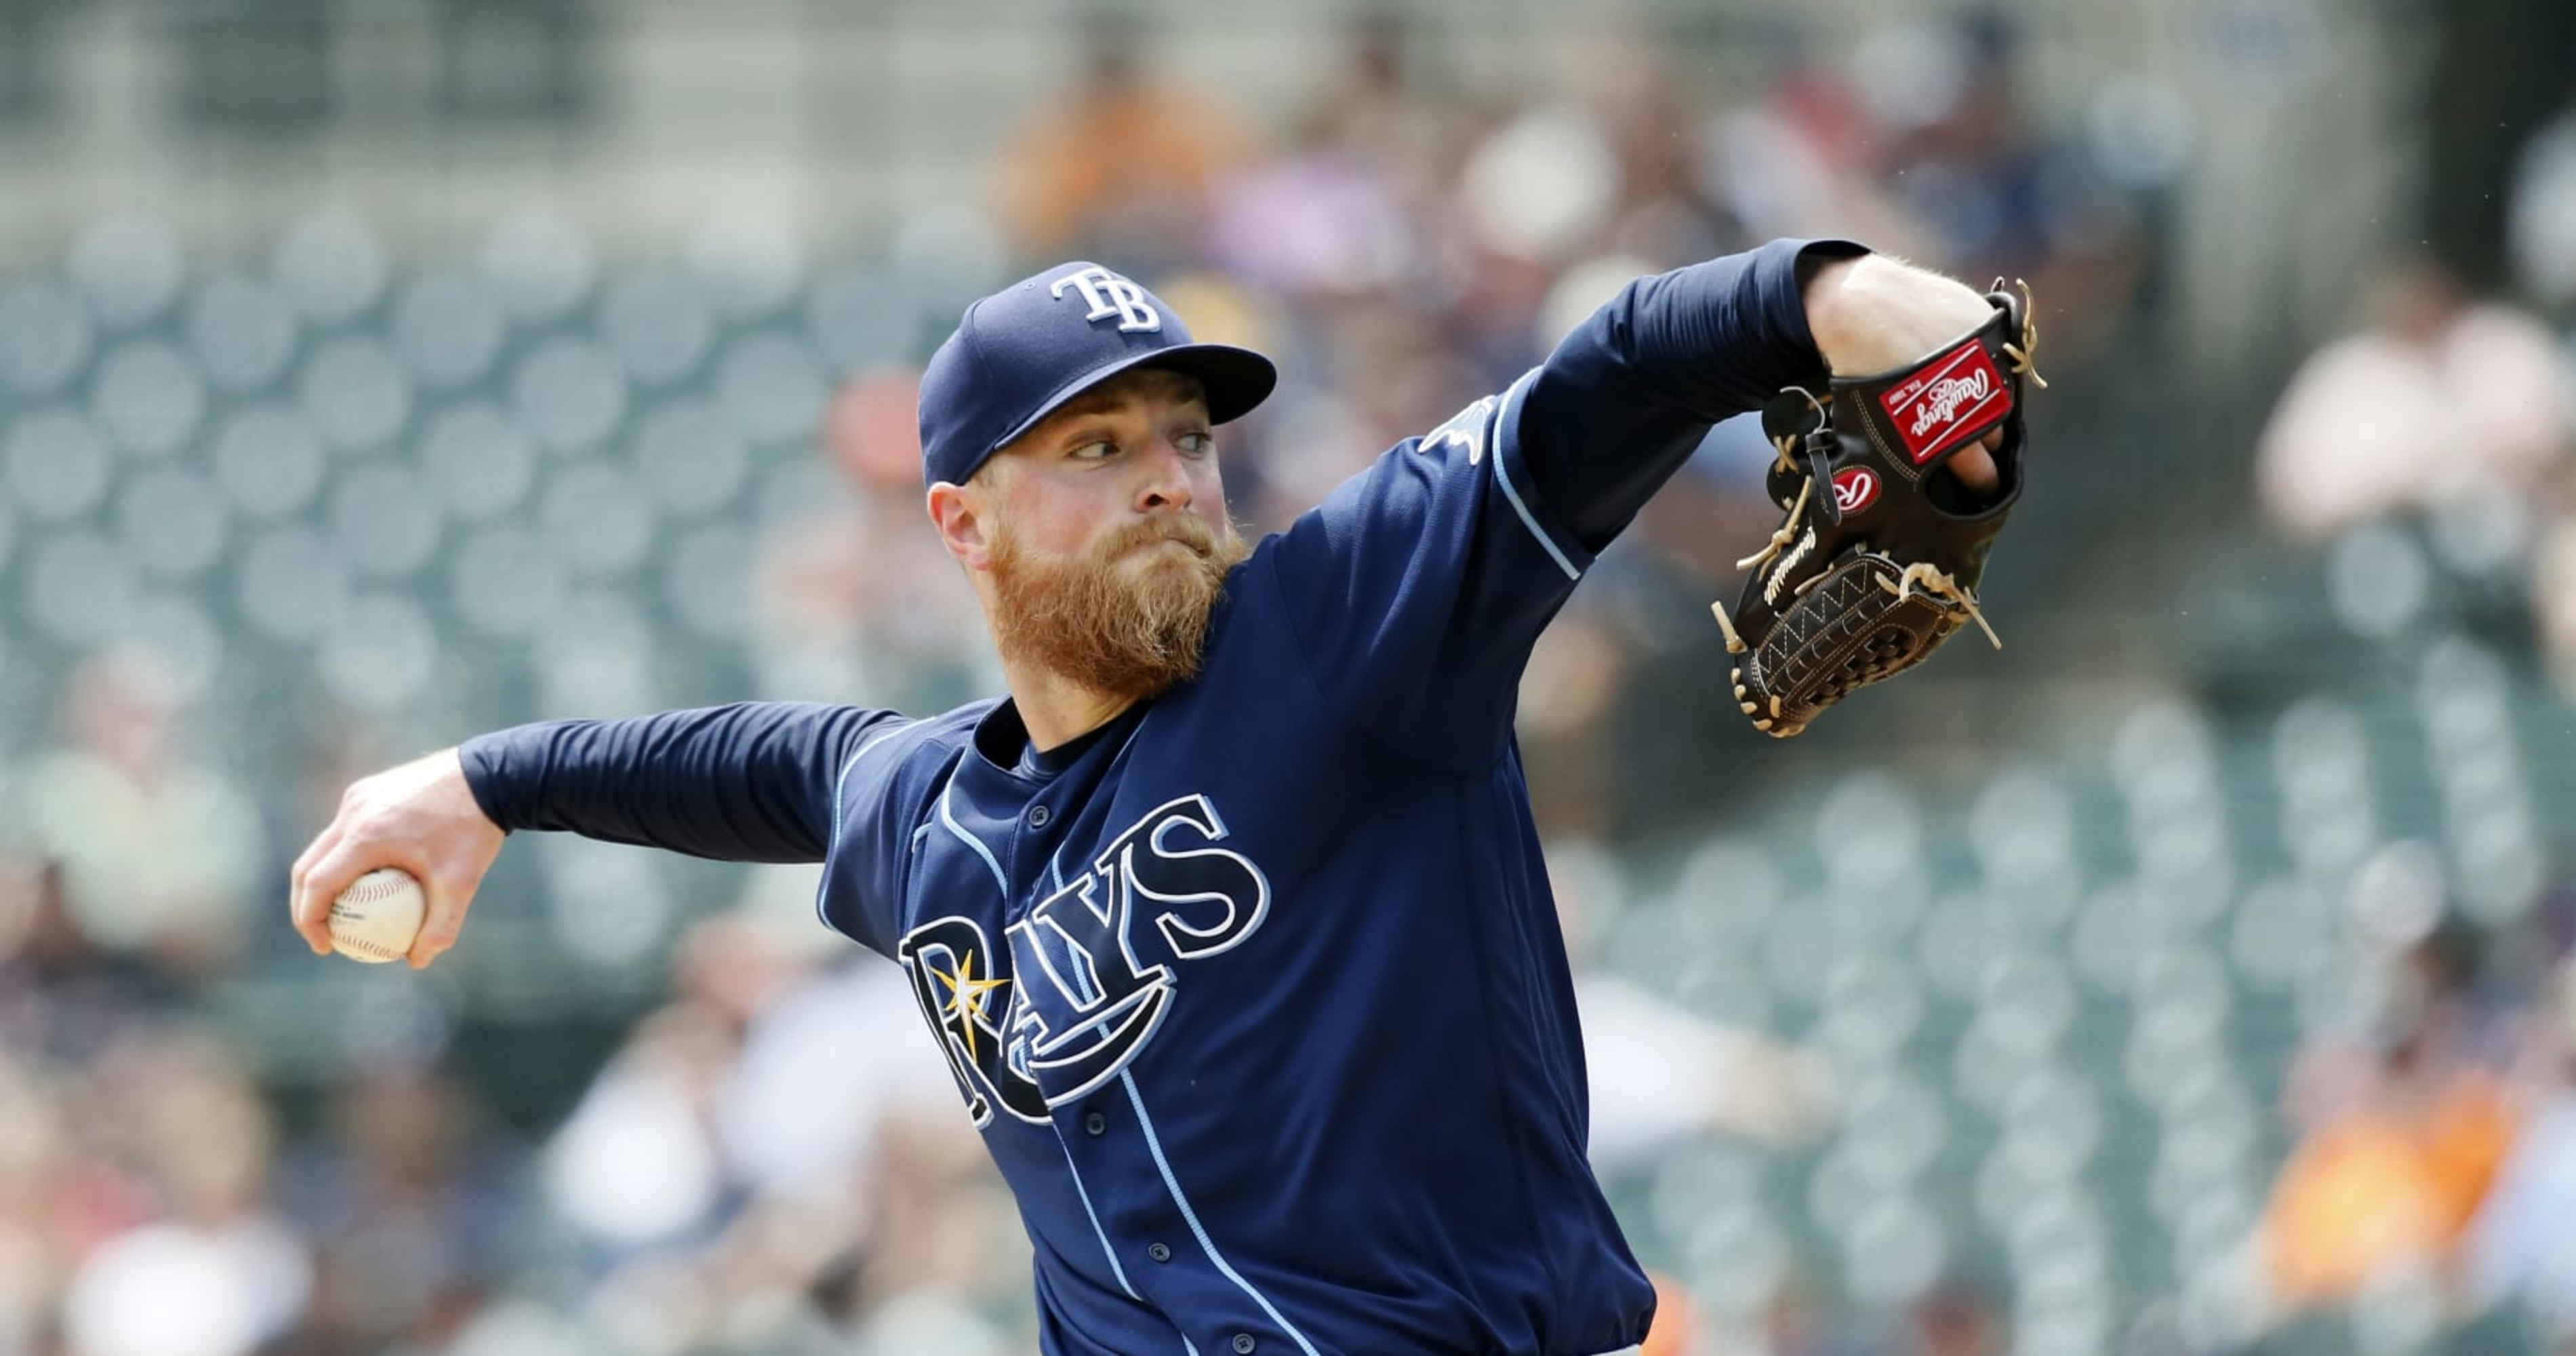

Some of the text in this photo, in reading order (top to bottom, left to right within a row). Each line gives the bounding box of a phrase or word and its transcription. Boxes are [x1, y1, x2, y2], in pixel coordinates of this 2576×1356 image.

[1050, 267, 1161, 333] TB
[1911, 368, 1989, 437] Rawlings
[899, 793, 1271, 1128] RAYS
